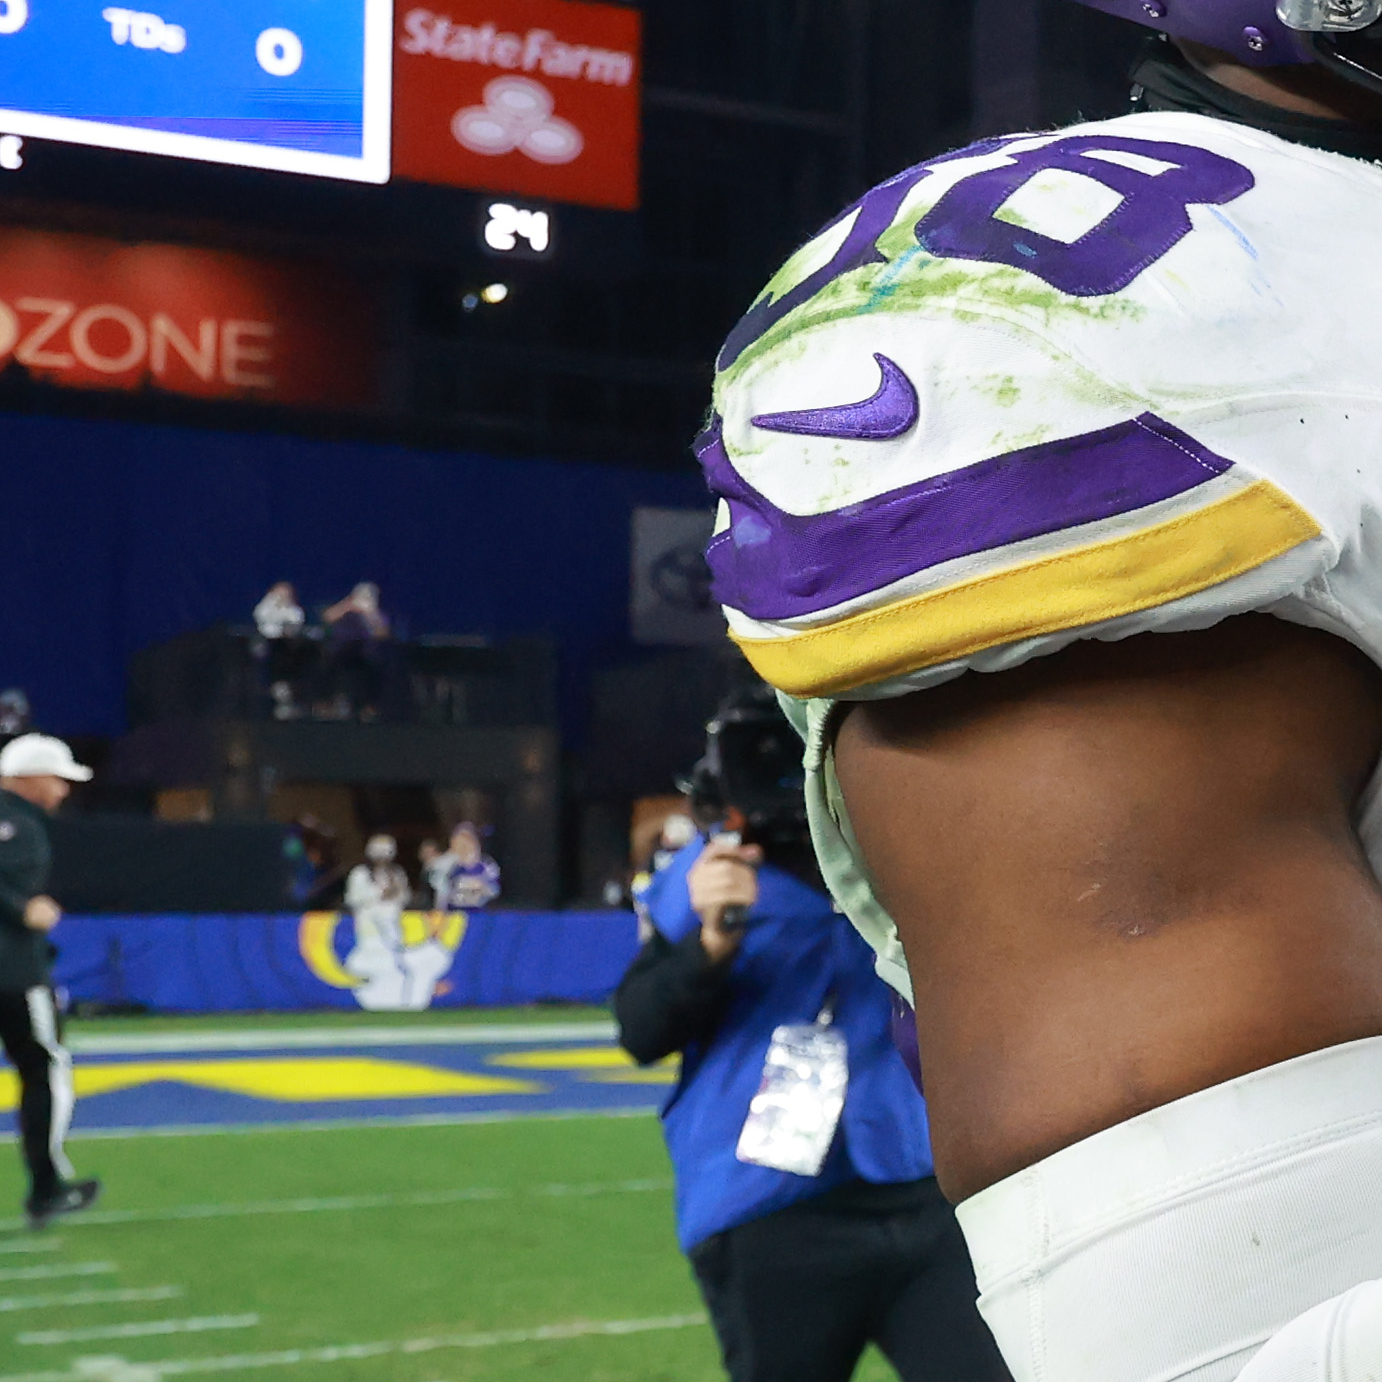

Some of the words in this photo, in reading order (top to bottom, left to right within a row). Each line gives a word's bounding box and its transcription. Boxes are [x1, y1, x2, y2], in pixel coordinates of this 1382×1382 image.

[102, 6, 187, 54] TDs
[255, 27, 303, 77] 0
[485, 203, 549, 252] 24
